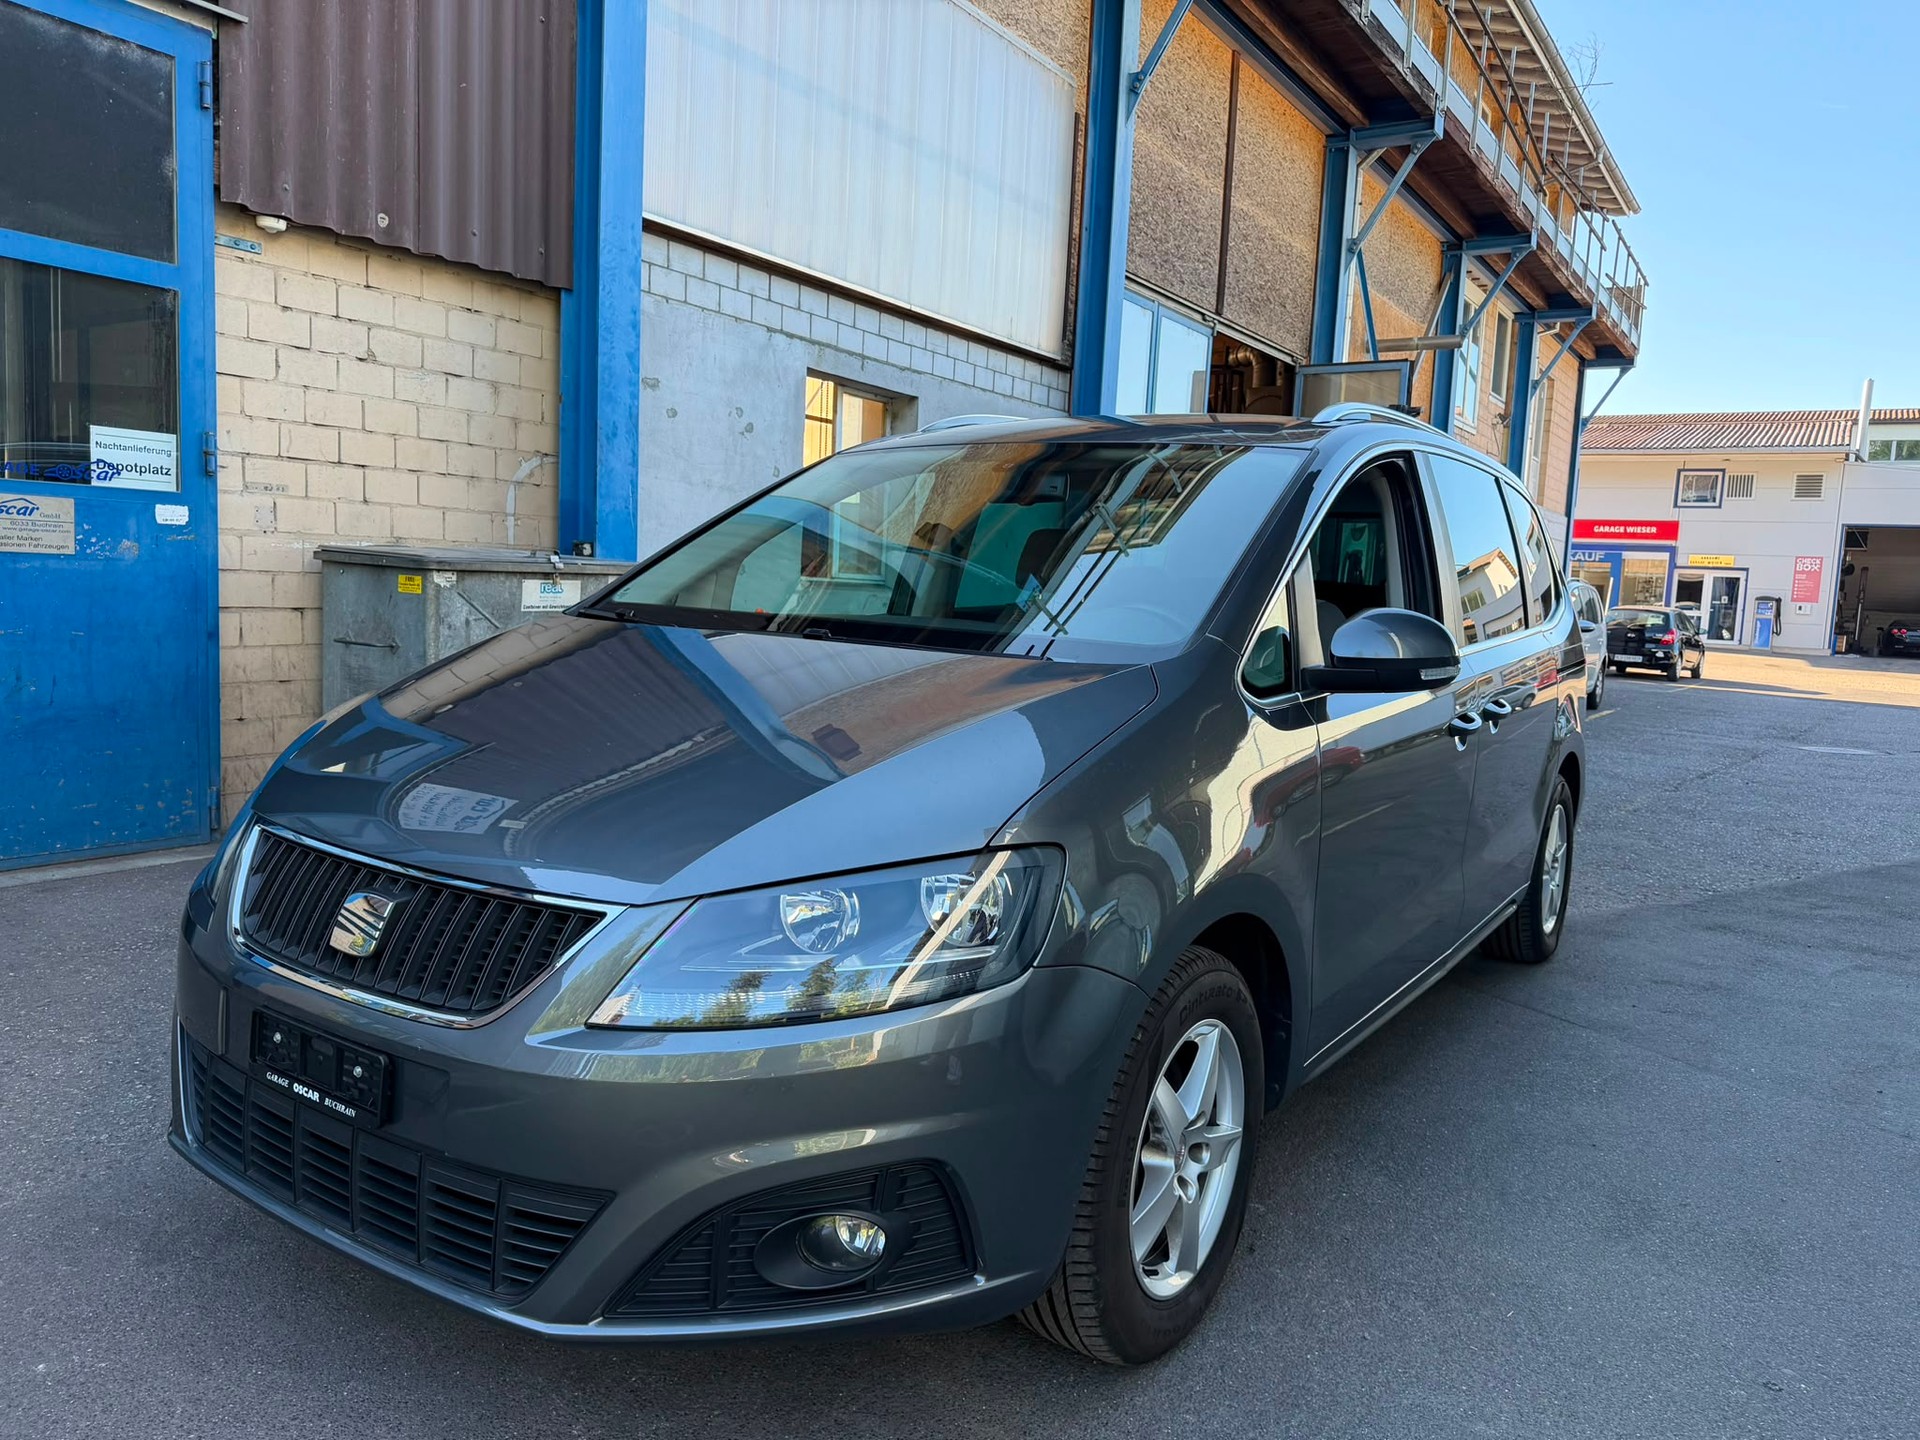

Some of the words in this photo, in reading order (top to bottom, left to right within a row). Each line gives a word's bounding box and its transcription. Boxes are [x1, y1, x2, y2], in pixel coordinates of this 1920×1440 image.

[95, 441, 172, 458] Nachtanlieferung
[96, 459, 172, 476] Depotplatz
[31, 521, 64, 529] Buchrain
[1593, 525, 1625, 533] GARAGE
[1626, 526, 1657, 534] WIESER
[16, 534, 43, 542] Marken
[28, 542, 70, 551] Fahrzeugen
[1796, 557, 1821, 565] CHECK
[1796, 563, 1821, 572] BOX
[266, 1071, 290, 1088] GARAGE
[293, 1082, 320, 1103] OSCAR
[323, 1097, 357, 1118] BUCHRAIN
